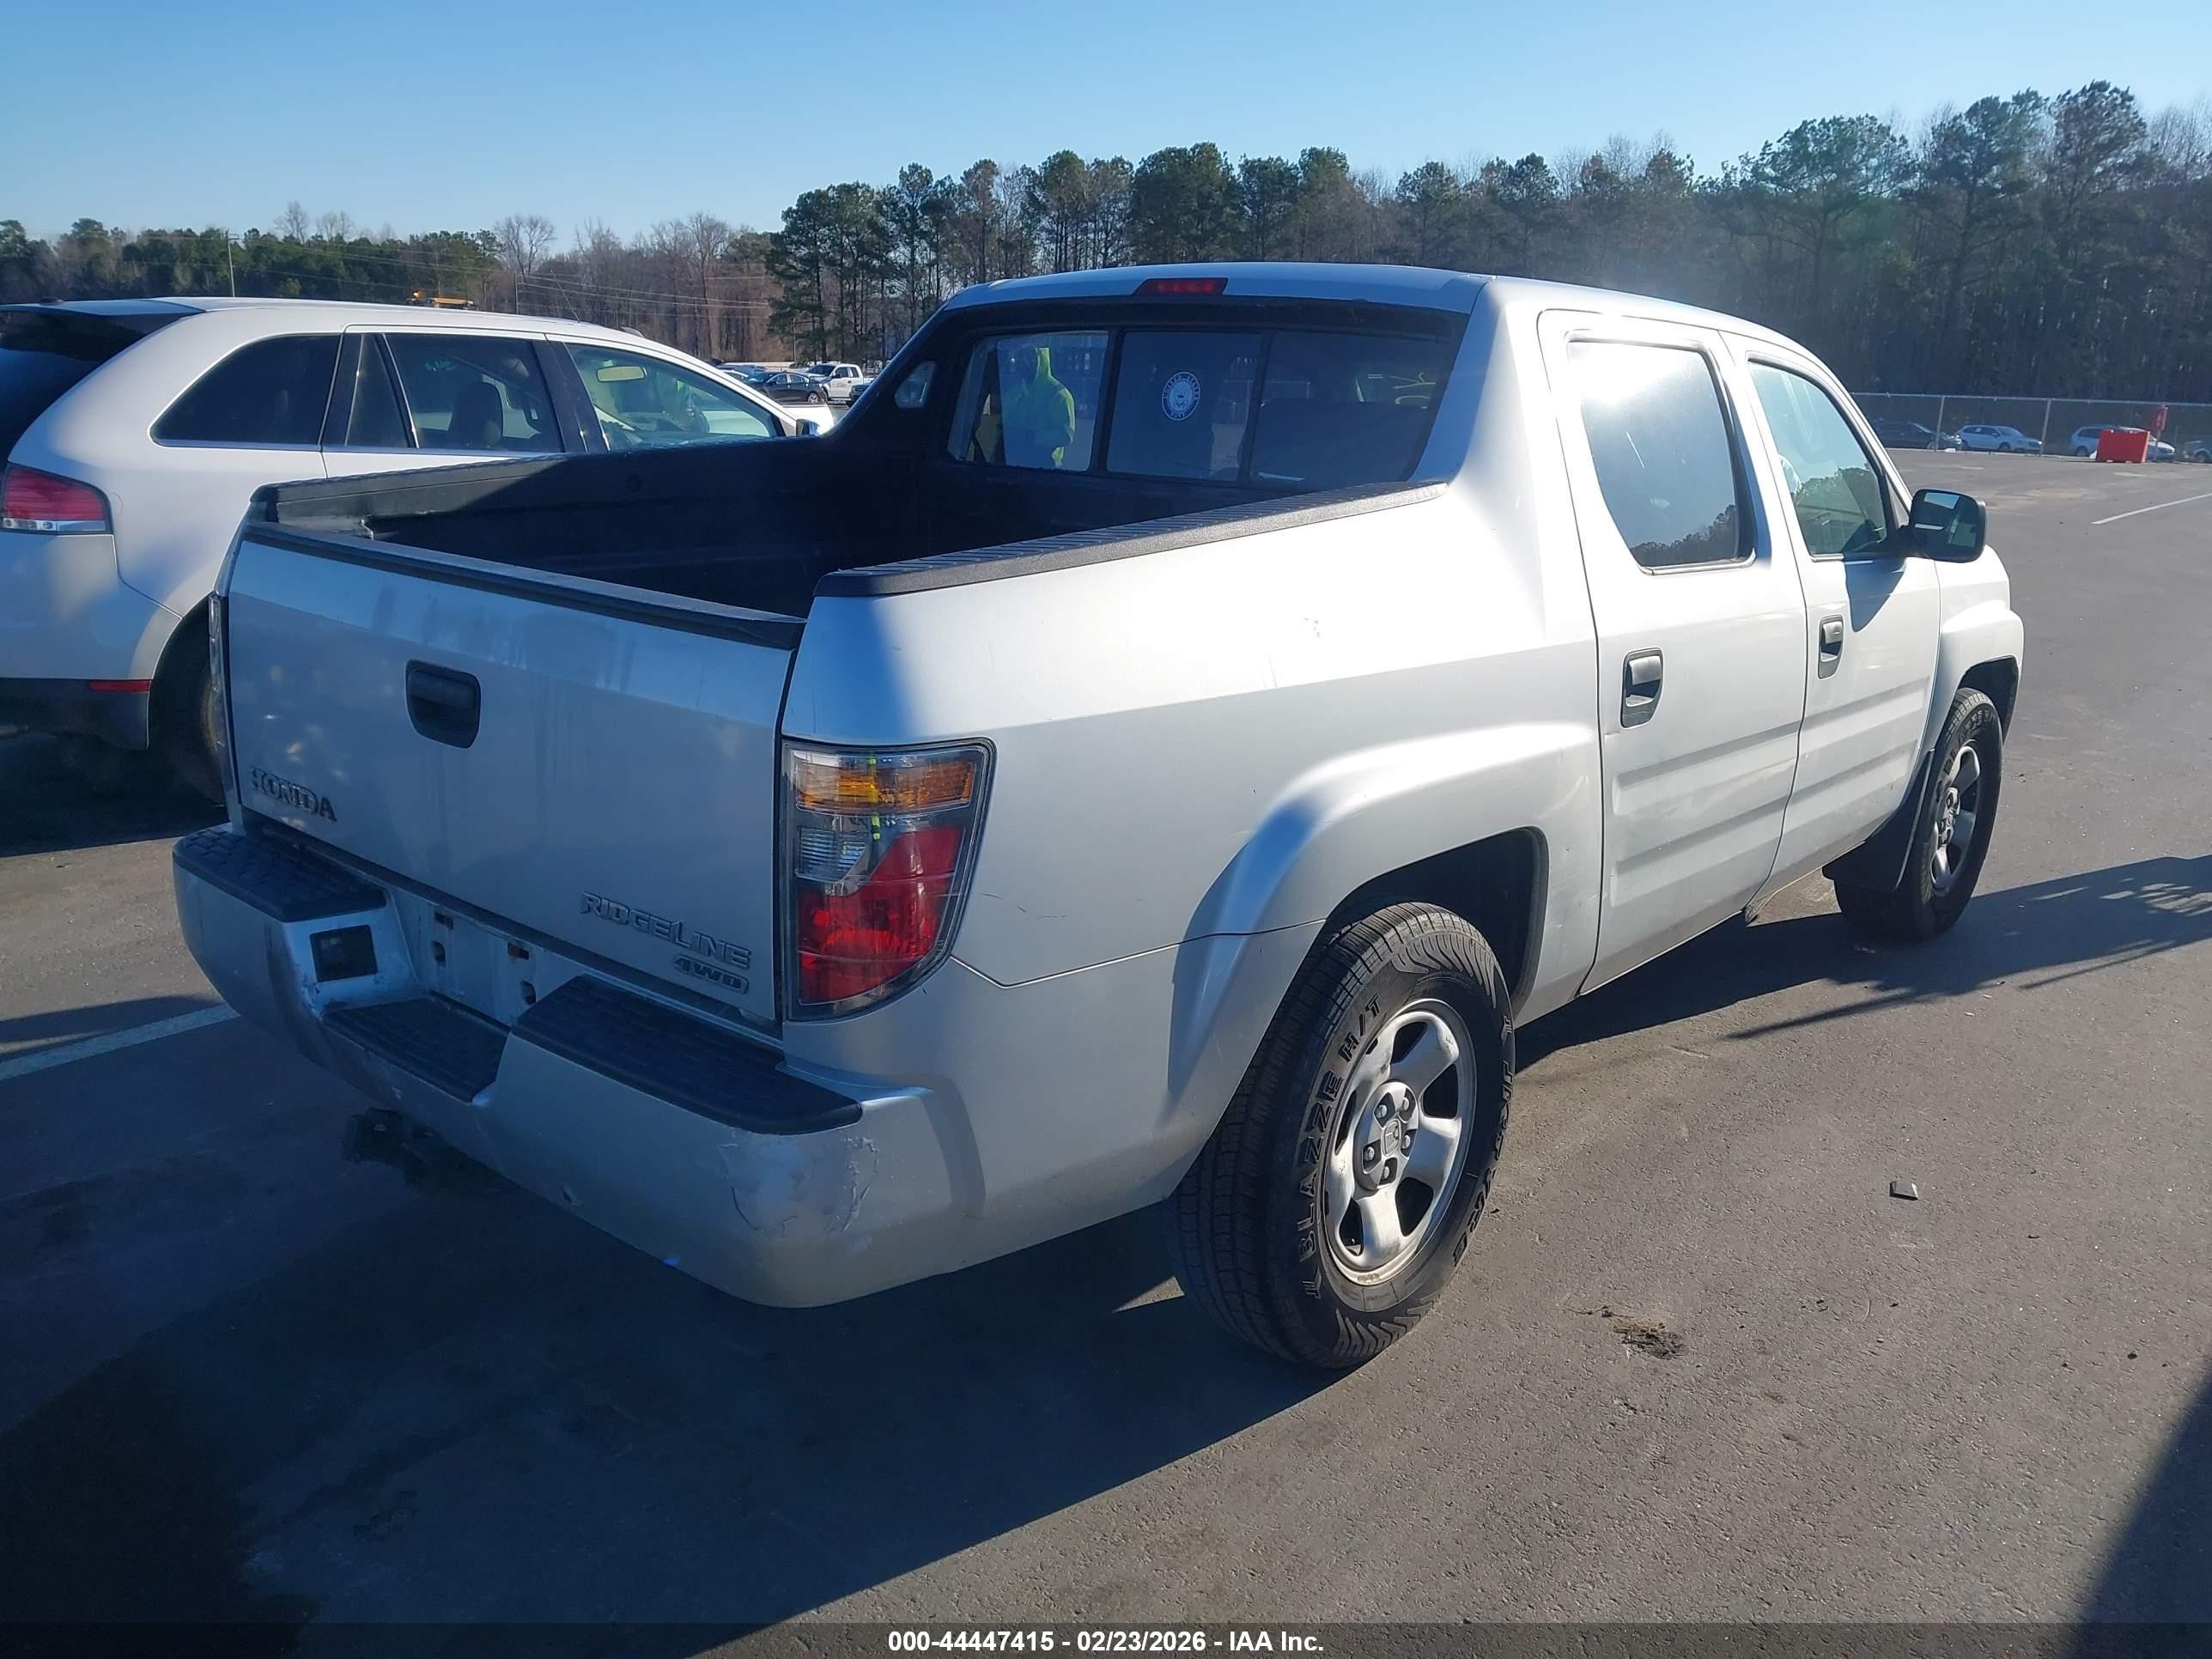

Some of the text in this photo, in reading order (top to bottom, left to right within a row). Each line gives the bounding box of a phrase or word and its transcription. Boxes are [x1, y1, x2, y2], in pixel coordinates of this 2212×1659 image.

[250, 767, 337, 822] HONDA
[580, 890, 752, 970] RIDGELINE
[673, 954, 746, 993] 4WD
[1297, 994, 1381, 1264] BLAZZE H/T
